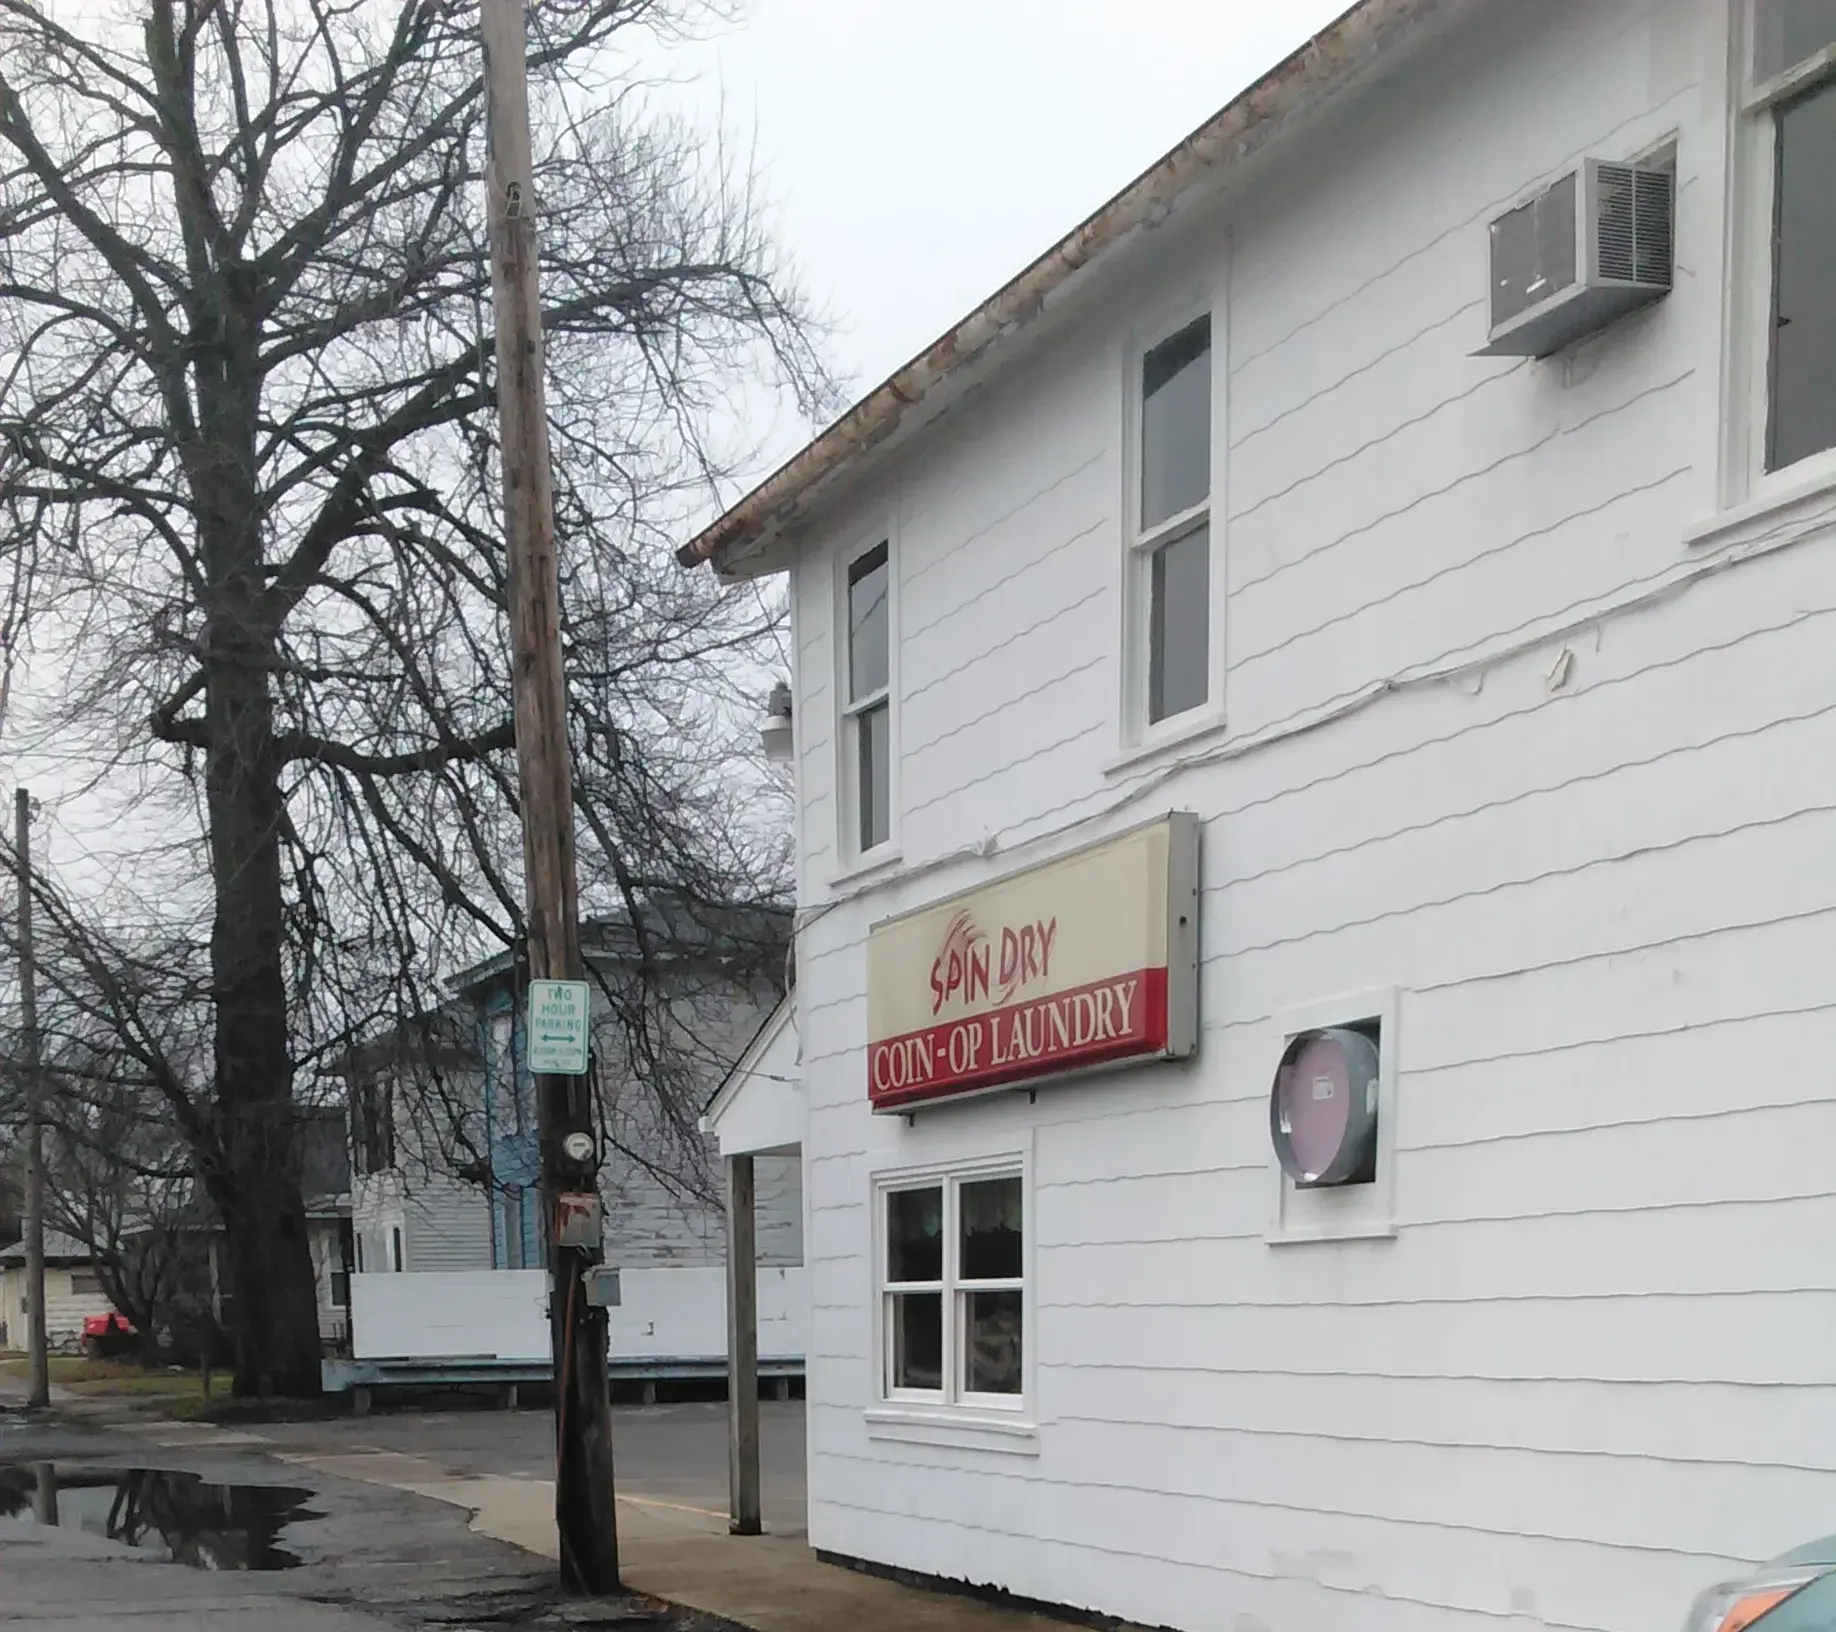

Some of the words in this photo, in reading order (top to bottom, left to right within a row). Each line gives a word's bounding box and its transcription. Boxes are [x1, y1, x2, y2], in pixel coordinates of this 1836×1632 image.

[930, 943, 990, 1016] SPIN
[999, 916, 1057, 986] DRY
[548, 988, 572, 1001] TWO
[541, 1004, 575, 1015] HOUR
[535, 1018, 581, 1031] PARKING
[873, 1022, 983, 1091] COIN-OP
[991, 980, 1137, 1066] LAUNDRY
